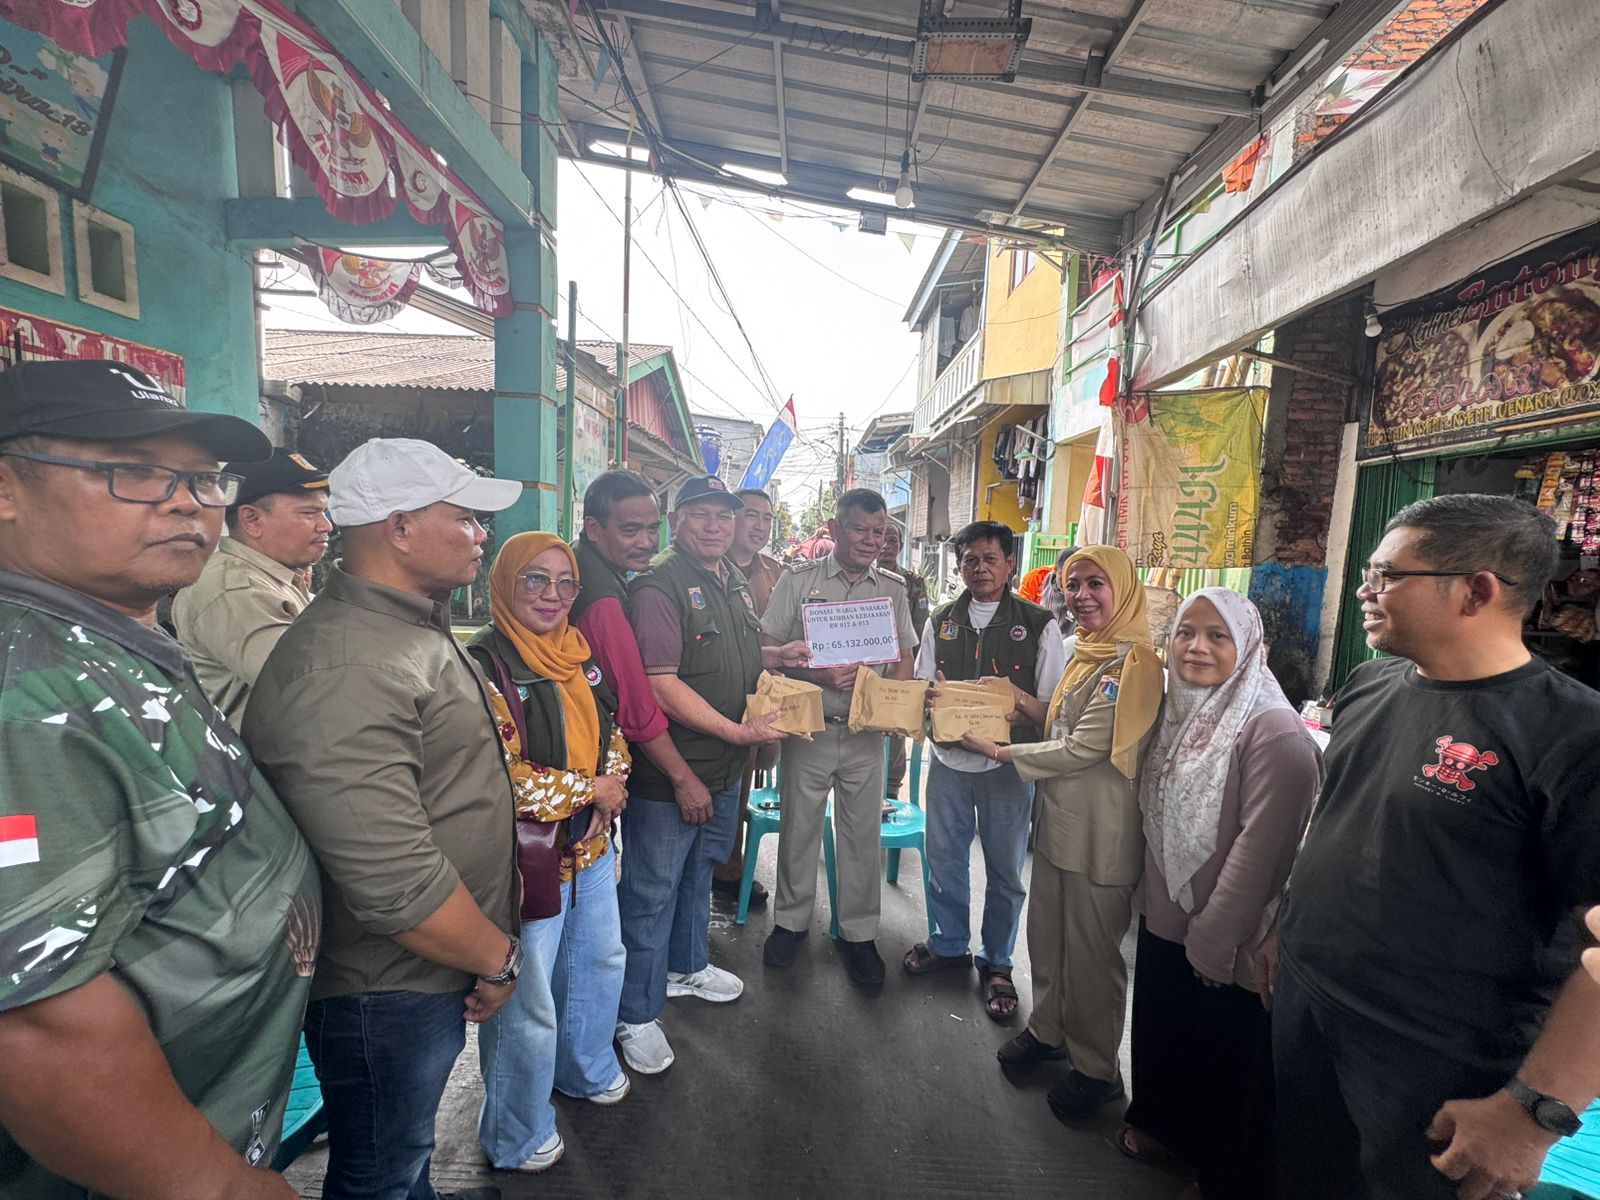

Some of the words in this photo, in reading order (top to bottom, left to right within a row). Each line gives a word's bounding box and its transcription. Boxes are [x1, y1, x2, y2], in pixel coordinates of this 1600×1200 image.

[1225, 501, 1239, 549] minkum
[810, 608, 833, 616] DONASI
[836, 606, 857, 614] WARGA
[860, 604, 889, 612] WARAKAS
[808, 616, 828, 624] UNTUK
[829, 614, 855, 622] KORBAN
[855, 611, 891, 620] KEBAKARAN
[812, 642, 824, 652] Rp
